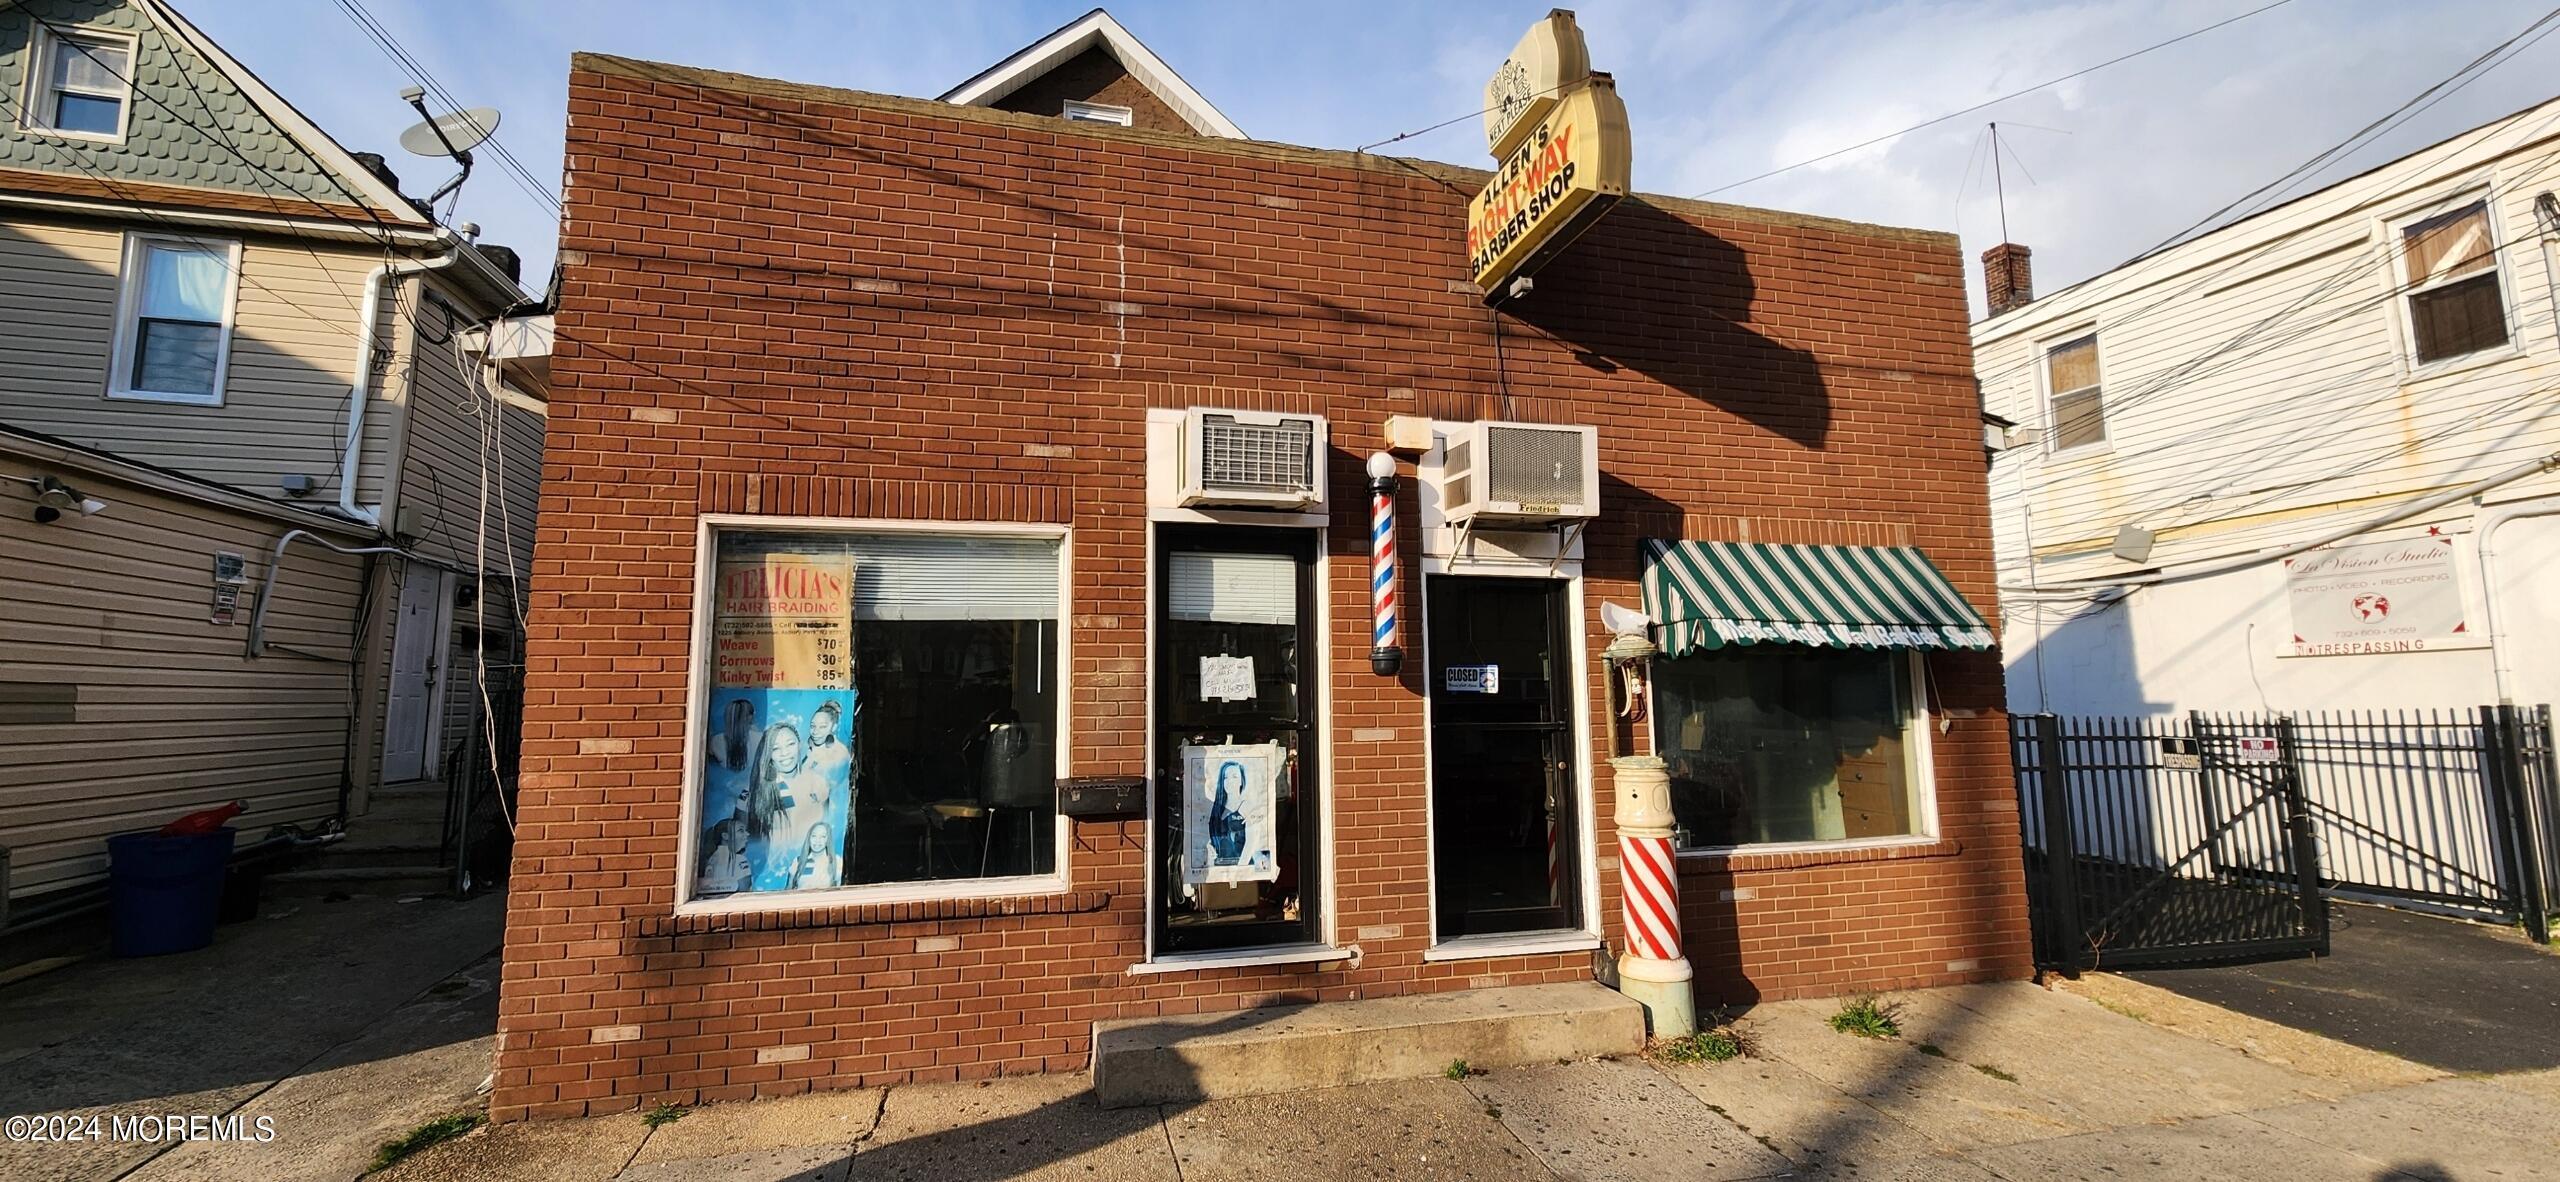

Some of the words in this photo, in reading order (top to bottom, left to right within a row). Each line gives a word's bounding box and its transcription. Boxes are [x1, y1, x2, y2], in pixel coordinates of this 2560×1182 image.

[1489, 117, 1504, 145] NEXT
[1506, 87, 1531, 125] PLEASE
[1483, 123, 1549, 211] ALLEN'S
[1471, 208, 1528, 277] BARBER
[1529, 162, 1575, 222] SHOP
[726, 565, 841, 599] FELICIA'S
[726, 602, 764, 613] HAIR
[768, 602, 839, 613] BRAIDING
[720, 639, 758, 650] Weave
[817, 638, 836, 650] $70
[720, 655, 775, 667] Cornrows
[817, 653, 836, 666] $30
[720, 670, 752, 684] Kinky
[755, 670, 785, 682] Twist
[817, 669, 836, 681] $85
[1448, 668, 1478, 682] CLOSED
[2250, 740, 2265, 750] NO
